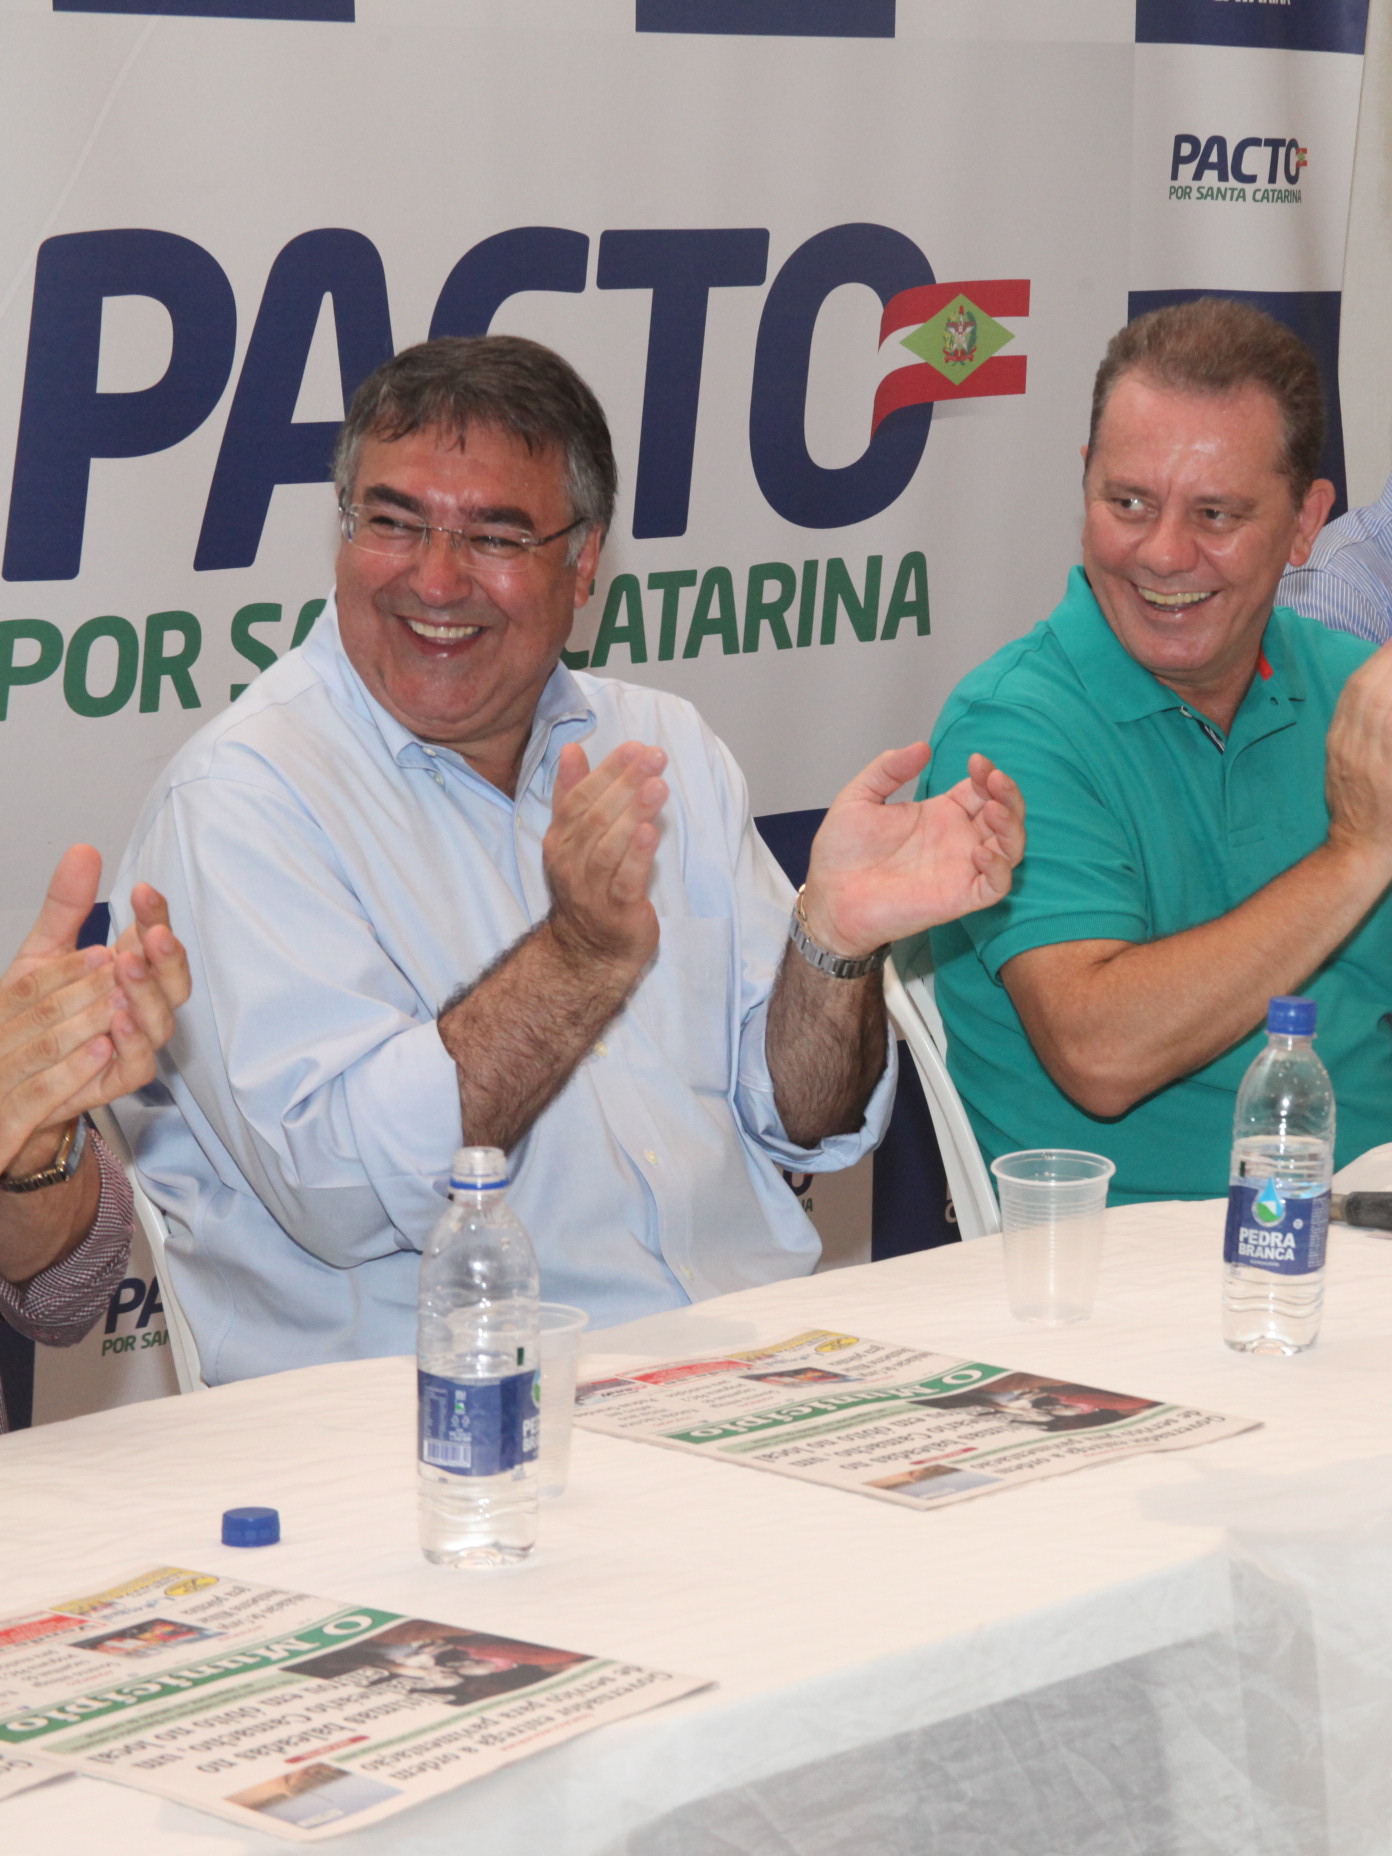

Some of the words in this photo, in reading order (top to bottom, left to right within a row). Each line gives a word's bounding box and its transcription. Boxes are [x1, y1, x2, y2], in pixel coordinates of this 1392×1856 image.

[1170, 134, 1300, 185] PACTO
[1169, 185, 1192, 200] POR
[1196, 186, 1247, 203] SANTA
[1252, 188, 1302, 203] CATARINA
[0, 610, 202, 722] POR
[1239, 1227, 1296, 1248] PEDRA
[1238, 1242, 1295, 1260] BRANCA
[102, 1335, 136, 1356] POR
[942, 1369, 982, 1385] O
[690, 1385, 940, 1437] Município
[322, 1614, 373, 1637] O
[6, 1637, 322, 1731] Município
